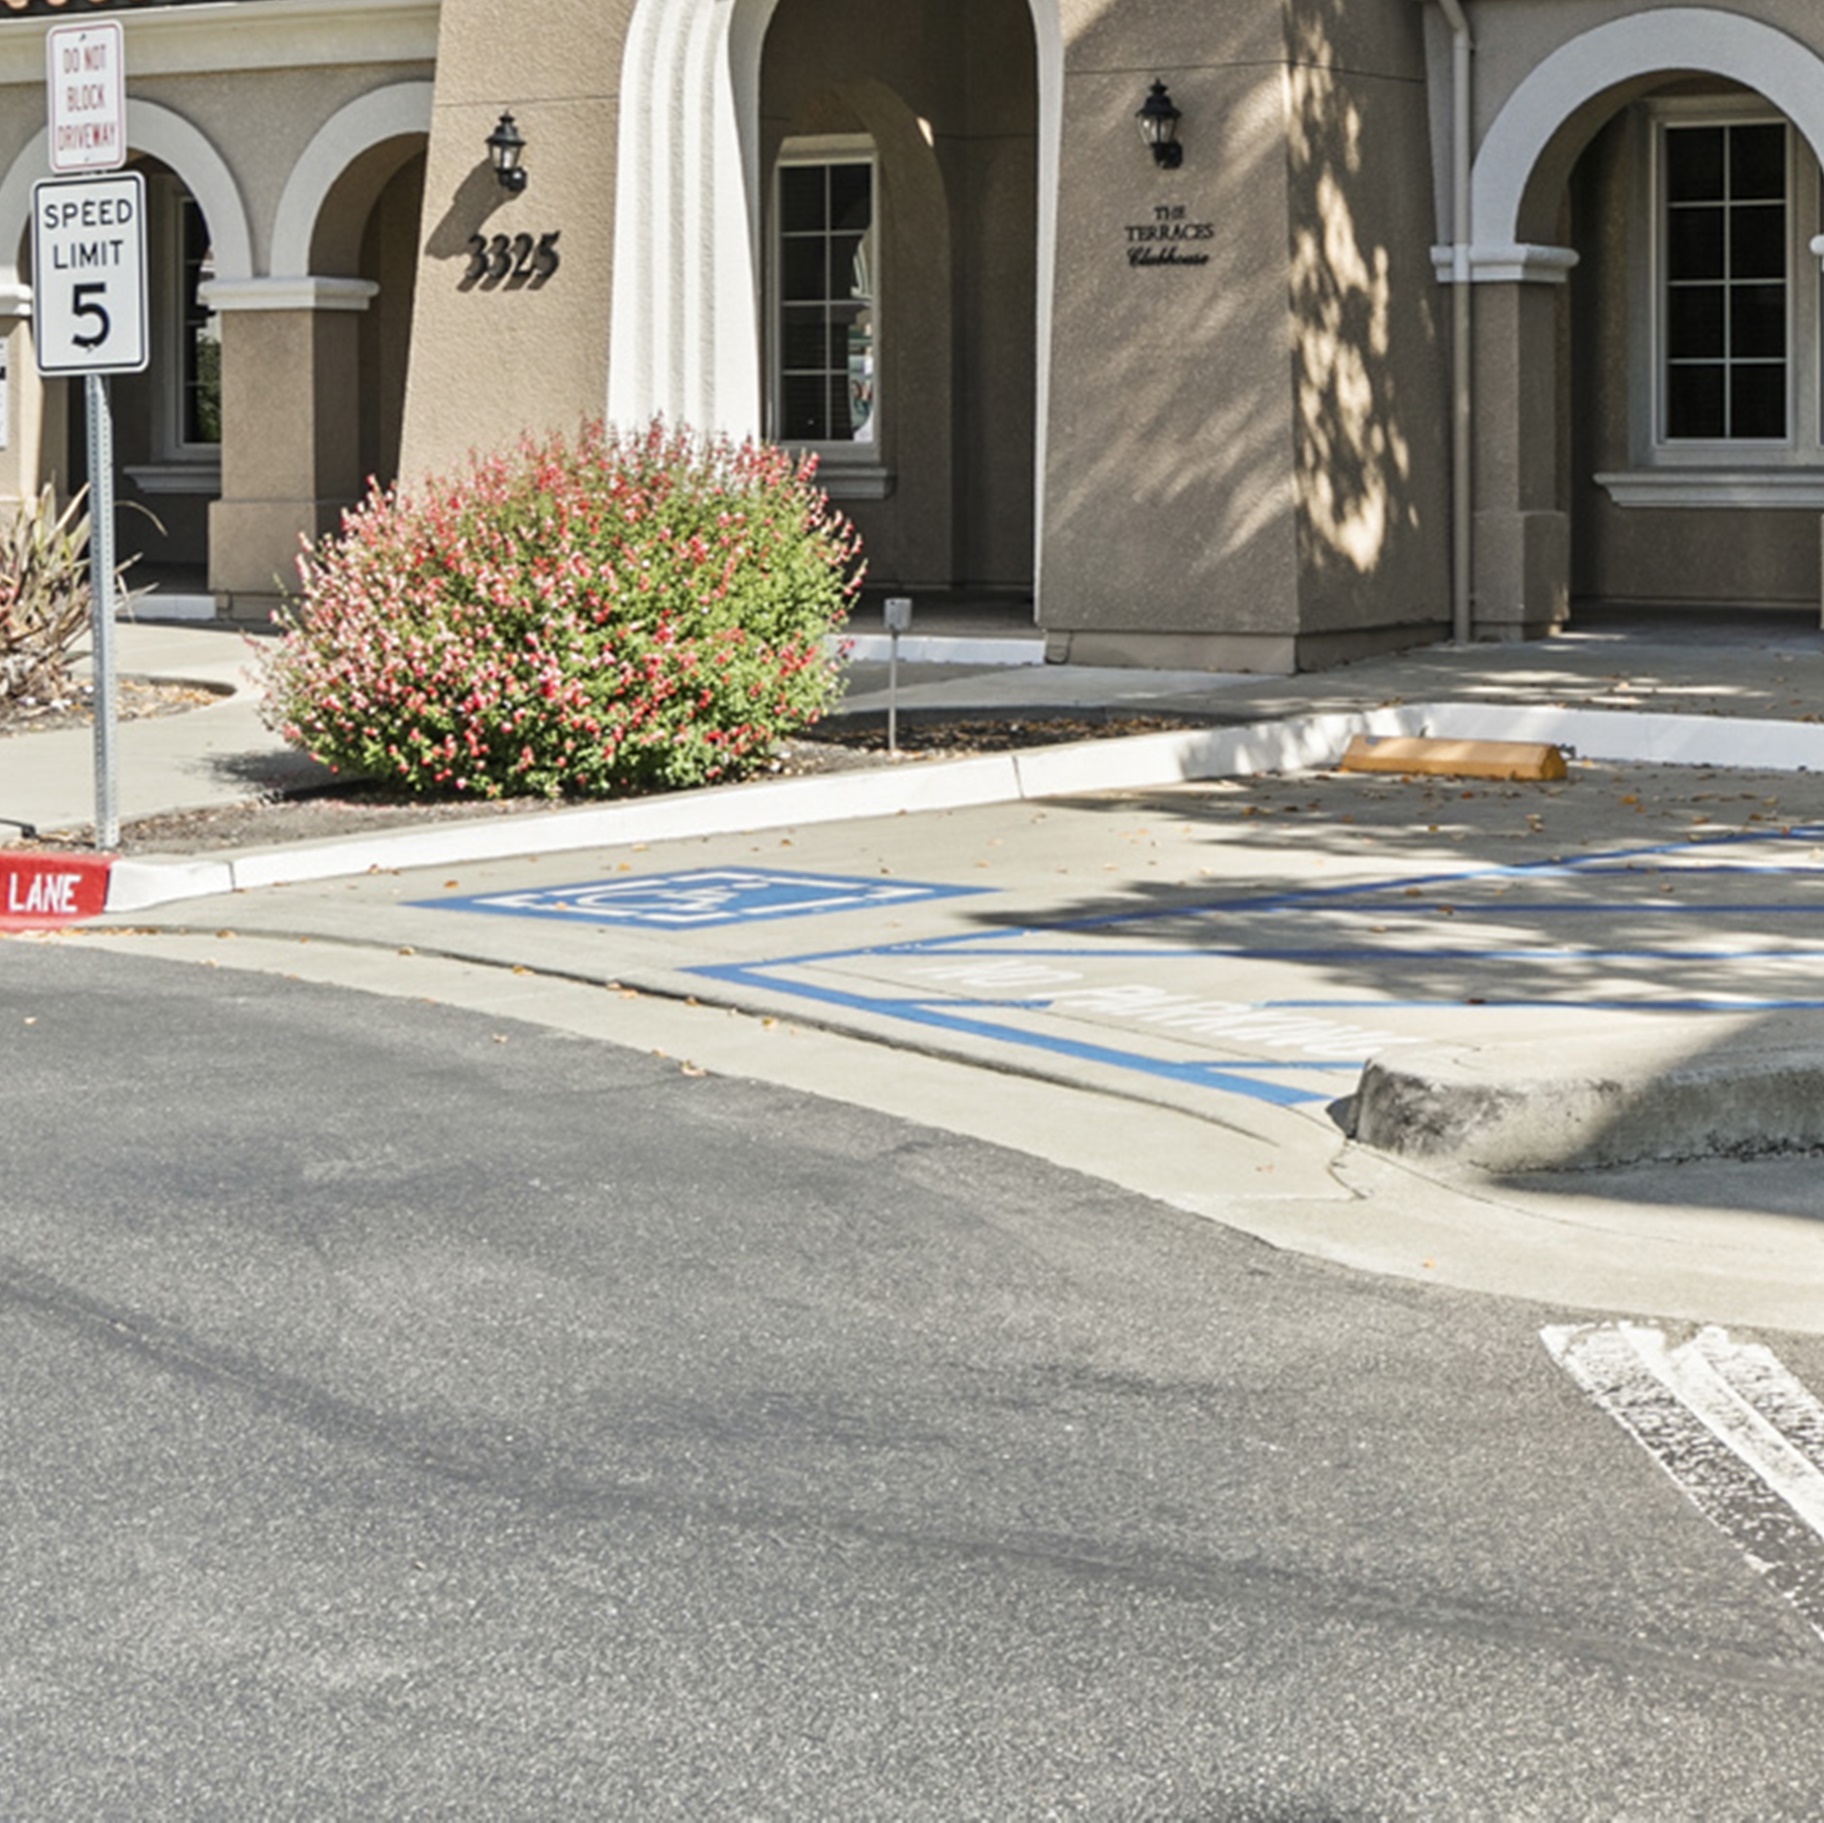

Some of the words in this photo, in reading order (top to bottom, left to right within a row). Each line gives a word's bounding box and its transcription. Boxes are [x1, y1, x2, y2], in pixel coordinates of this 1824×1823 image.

[63, 48, 81, 73] DO
[84, 44, 107, 71] NOT
[67, 85, 105, 112] BLOCK
[58, 123, 116, 151] DRIVEWAY
[44, 198, 133, 230] SPEED
[1154, 205, 1186, 221] THE
[1124, 223, 1214, 242] TERRACES
[53, 238, 124, 270] LIMIT
[467, 230, 562, 280] 3325
[1127, 246, 1209, 267] Clubhouse
[72, 282, 111, 349] 5
[8, 872, 81, 913] LANE
[907, 960, 1083, 987] NO
[1027, 985, 1426, 1056] PARKING
